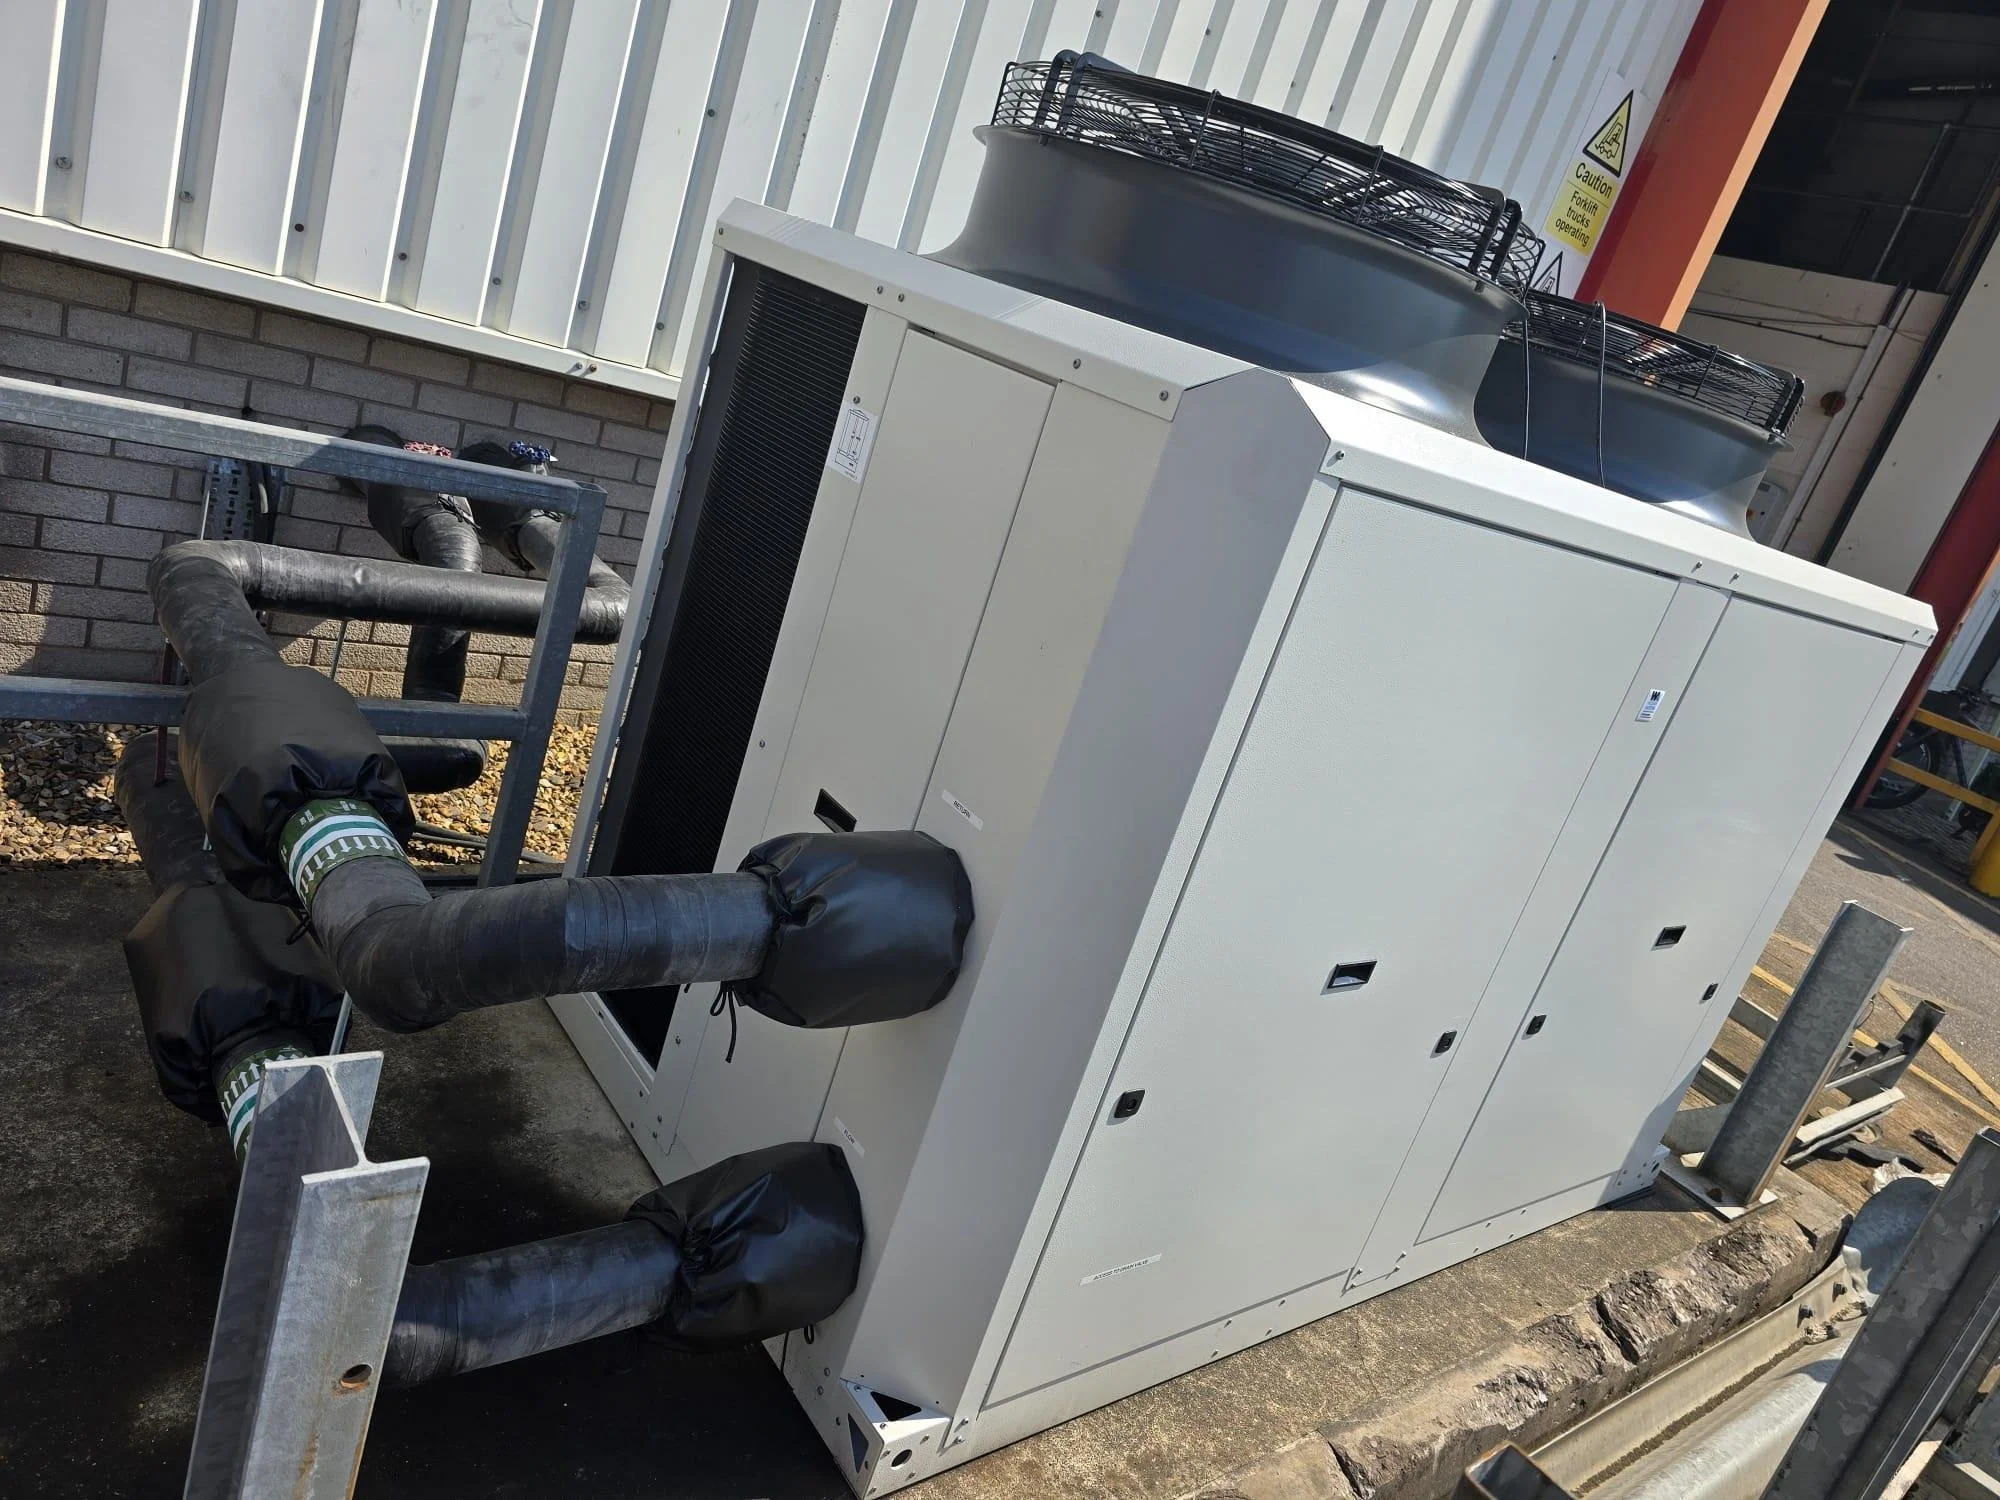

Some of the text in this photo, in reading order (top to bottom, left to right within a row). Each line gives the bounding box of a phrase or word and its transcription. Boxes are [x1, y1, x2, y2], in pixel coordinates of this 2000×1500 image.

[1575, 162, 1613, 197] Caution
[1570, 190, 1599, 216] Forklift
[1566, 206, 1591, 228] trucks
[1555, 218, 1590, 247] operating
